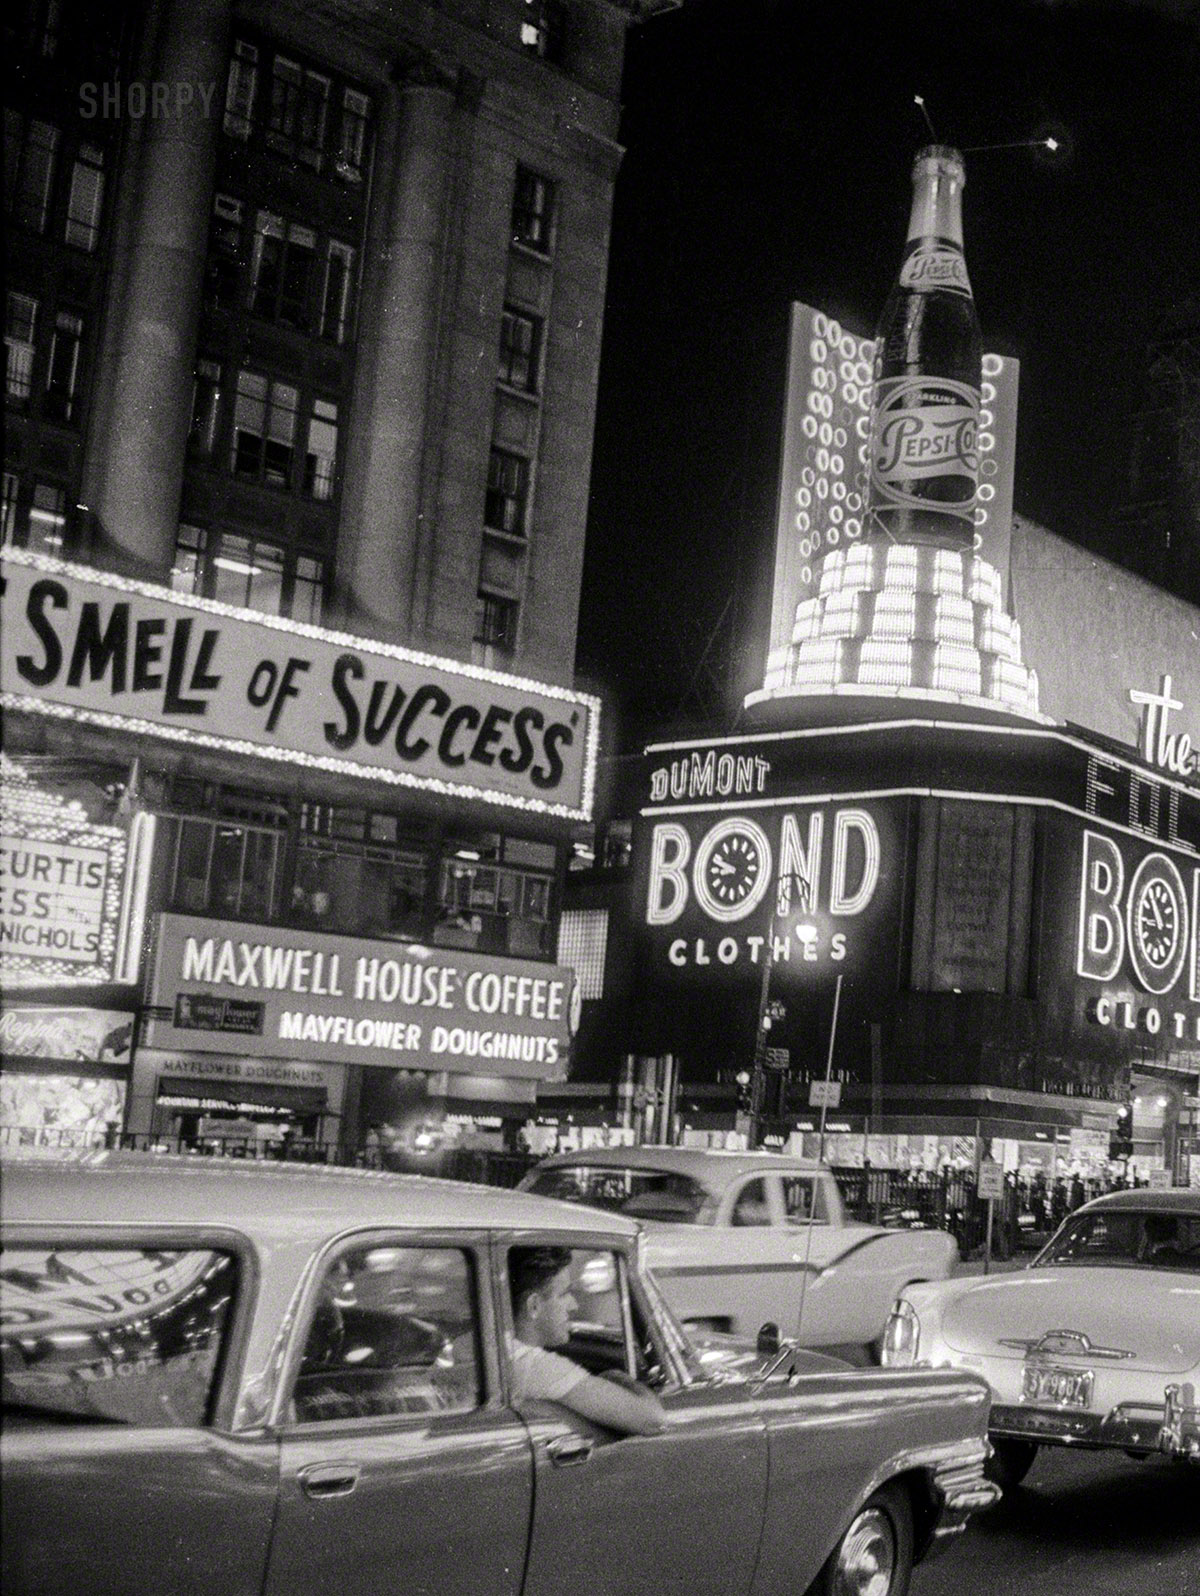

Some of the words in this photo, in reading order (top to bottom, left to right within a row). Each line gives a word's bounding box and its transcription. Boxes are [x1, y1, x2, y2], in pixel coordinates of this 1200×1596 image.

[17, 579, 221, 714] SMELL
[247, 660, 310, 732] OF
[1130, 675, 1192, 776] The
[650, 750, 770, 800] DUMONT
[646, 808, 880, 925] BOND
[0, 920, 100, 953] NICHOLS
[669, 933, 847, 966] CLOTHES
[182, 936, 343, 997] MAXWELL
[355, 957, 457, 1010] HOUSE
[466, 971, 564, 1020] COFFEE
[279, 1011, 422, 1051] MAYFLOWER
[431, 1026, 560, 1064] DOUGHNUTS
